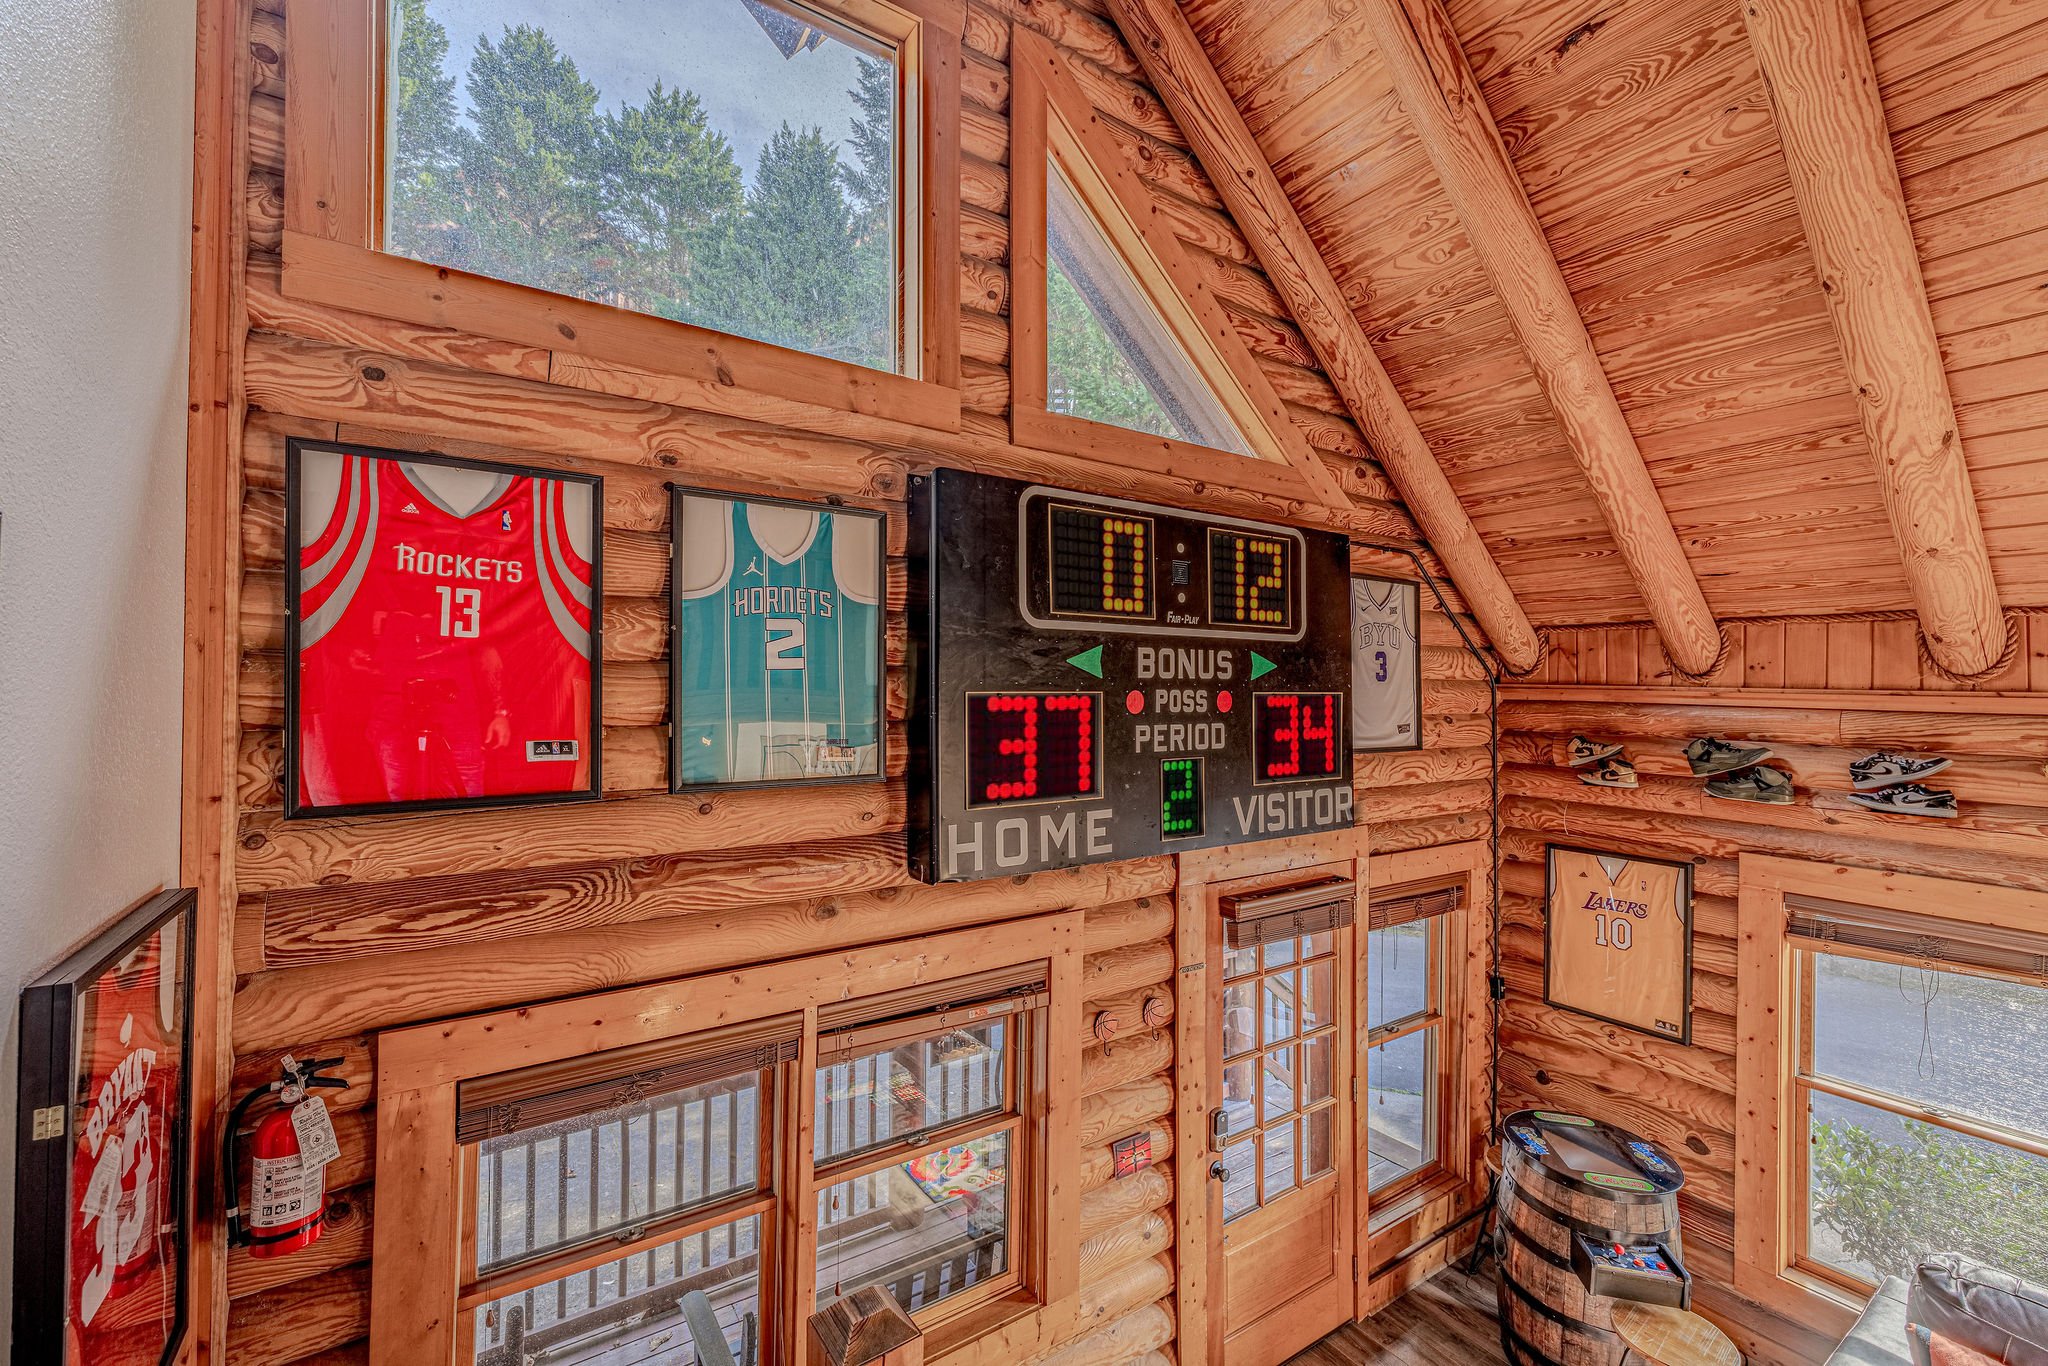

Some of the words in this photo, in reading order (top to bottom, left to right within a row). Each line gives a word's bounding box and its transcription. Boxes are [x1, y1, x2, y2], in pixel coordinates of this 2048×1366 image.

[393, 542, 523, 583] ROCKETS
[1236, 538, 1283, 623] 12
[436, 585, 481, 638] 13
[732, 586, 835, 618] HORNETS
[765, 618, 805, 670] 2
[1359, 622, 1401, 651] BYU
[1137, 647, 1234, 681] BONUS
[1375, 651, 1387, 682] 3
[1155, 689, 1208, 714] POSS
[986, 695, 1091, 801] 37
[1134, 723, 1227, 753] PERIOD
[1266, 694, 1334, 777] 34
[1162, 759, 1193, 832] 2
[1232, 785, 1354, 836] VISITOR
[947, 808, 1115, 875] HOME
[1581, 891, 1648, 919] LAKERS
[1595, 913, 1633, 951] 10
[86, 1048, 157, 1159] BRYANT
